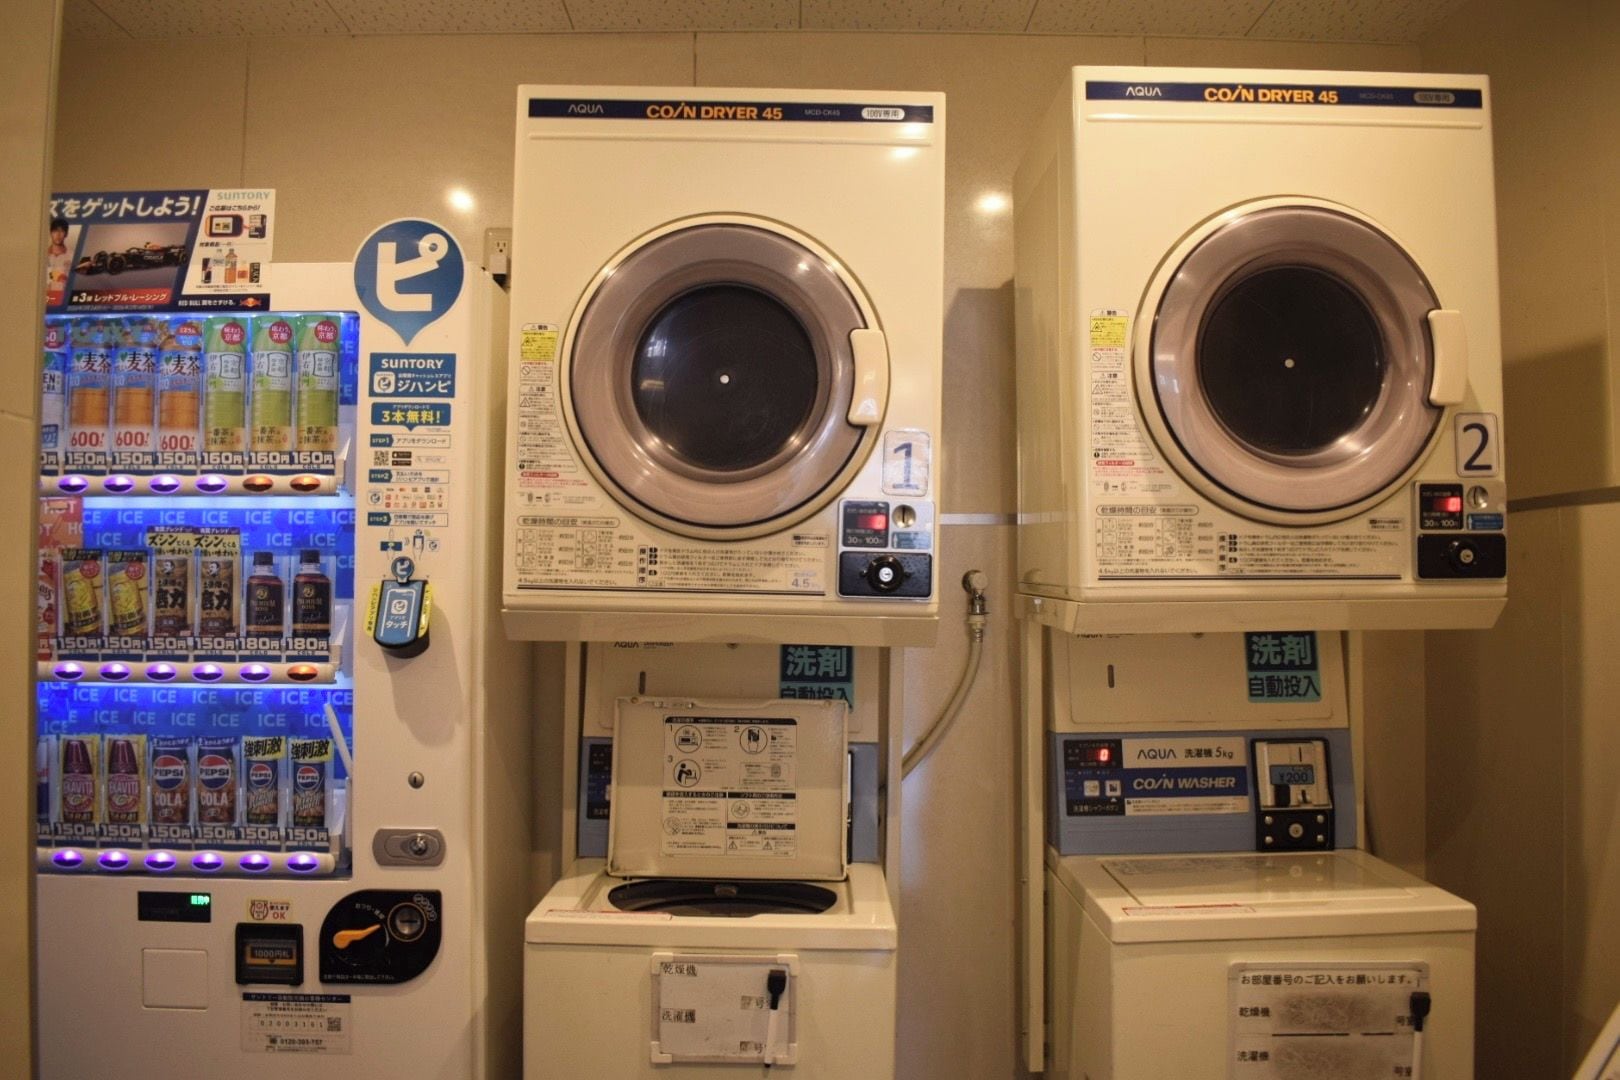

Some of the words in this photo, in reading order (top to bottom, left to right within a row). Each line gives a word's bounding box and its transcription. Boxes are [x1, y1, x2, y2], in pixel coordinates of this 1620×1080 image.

[1125, 86, 1162, 97] AQUA
[1204, 85, 1254, 102] COIN
[1258, 89, 1314, 103] DRYER
[1318, 91, 1339, 104] 45
[568, 104, 605, 114] AQUA
[646, 102, 696, 118] COIN
[701, 106, 758, 120] DRYER
[762, 107, 783, 120] 45
[217, 191, 271, 200] SUNTORY
[376, 232, 449, 313] ピ
[82, 351, 112, 374] 麦茶
[127, 351, 156, 374] 麦茶
[171, 354, 201, 377] 麦茶
[381, 358, 444, 369] SUNTORY
[397, 379, 452, 393] ジハンピ
[381, 409, 441, 424] 3本無料!
[1462, 422, 1493, 471] 2
[66, 452, 107, 466] 150円
[113, 452, 153, 466] 150円
[157, 452, 196, 466] 150円
[202, 452, 242, 465] 160円
[250, 452, 289, 465] 160円
[293, 452, 333, 465] 160円
[892, 442, 920, 490] 1
[84, 511, 101, 524] CE
[117, 511, 143, 524] ICE
[159, 511, 185, 524] ICE
[202, 511, 228, 524] ICE
[245, 511, 272, 524] ICE
[288, 511, 314, 524] ICE
[96, 532, 122, 546] ICE
[266, 532, 293, 546] ICE
[310, 532, 336, 546] ICE
[386, 621, 408, 629] タッチ
[59, 636, 97, 649] 150円
[102, 636, 141, 649] 150円
[148, 637, 186, 650] 150円
[194, 637, 236, 650] 150円
[238, 637, 280, 650] 180円
[286, 637, 328, 650] 180円
[1251, 635, 1312, 666] 洗剤
[785, 647, 848, 678] 洗剤
[1248, 675, 1320, 698] 自動投入
[73, 688, 99, 701] ICE
[114, 689, 138, 702] ICE
[151, 690, 177, 703] ICE
[192, 691, 218, 704] ICE
[235, 691, 263, 704] ICE
[281, 691, 309, 704] ICE
[326, 691, 353, 704] ICE
[94, 710, 119, 724] ICE
[132, 711, 156, 725] ICE
[171, 713, 196, 726] ICE
[212, 714, 240, 727] ICE
[258, 714, 286, 727] ICE
[244, 737, 282, 757] 強刺激
[290, 740, 330, 760] 強刺激
[1136, 748, 1177, 760] AQUA
[1184, 748, 1213, 759] 洗濯機
[1215, 746, 1234, 759] 5kg
[154, 768, 184, 777] PEPSI
[199, 768, 230, 777] PEPSI
[1132, 772, 1174, 790] COIN
[1178, 776, 1236, 790] WASHER
[55, 824, 96, 836] 150円
[100, 824, 141, 837] 150円
[149, 826, 191, 838] 150円
[196, 827, 236, 839] 150円
[238, 828, 279, 840] 150円
[285, 829, 328, 841] 150円
[662, 963, 697, 977] 乾燥機
[1241, 974, 1413, 986] お部屋番号のご記入をお願いします。
[1239, 1007, 1271, 1018] 乾燥機
[1237, 1051, 1270, 1062] 洗濯機
